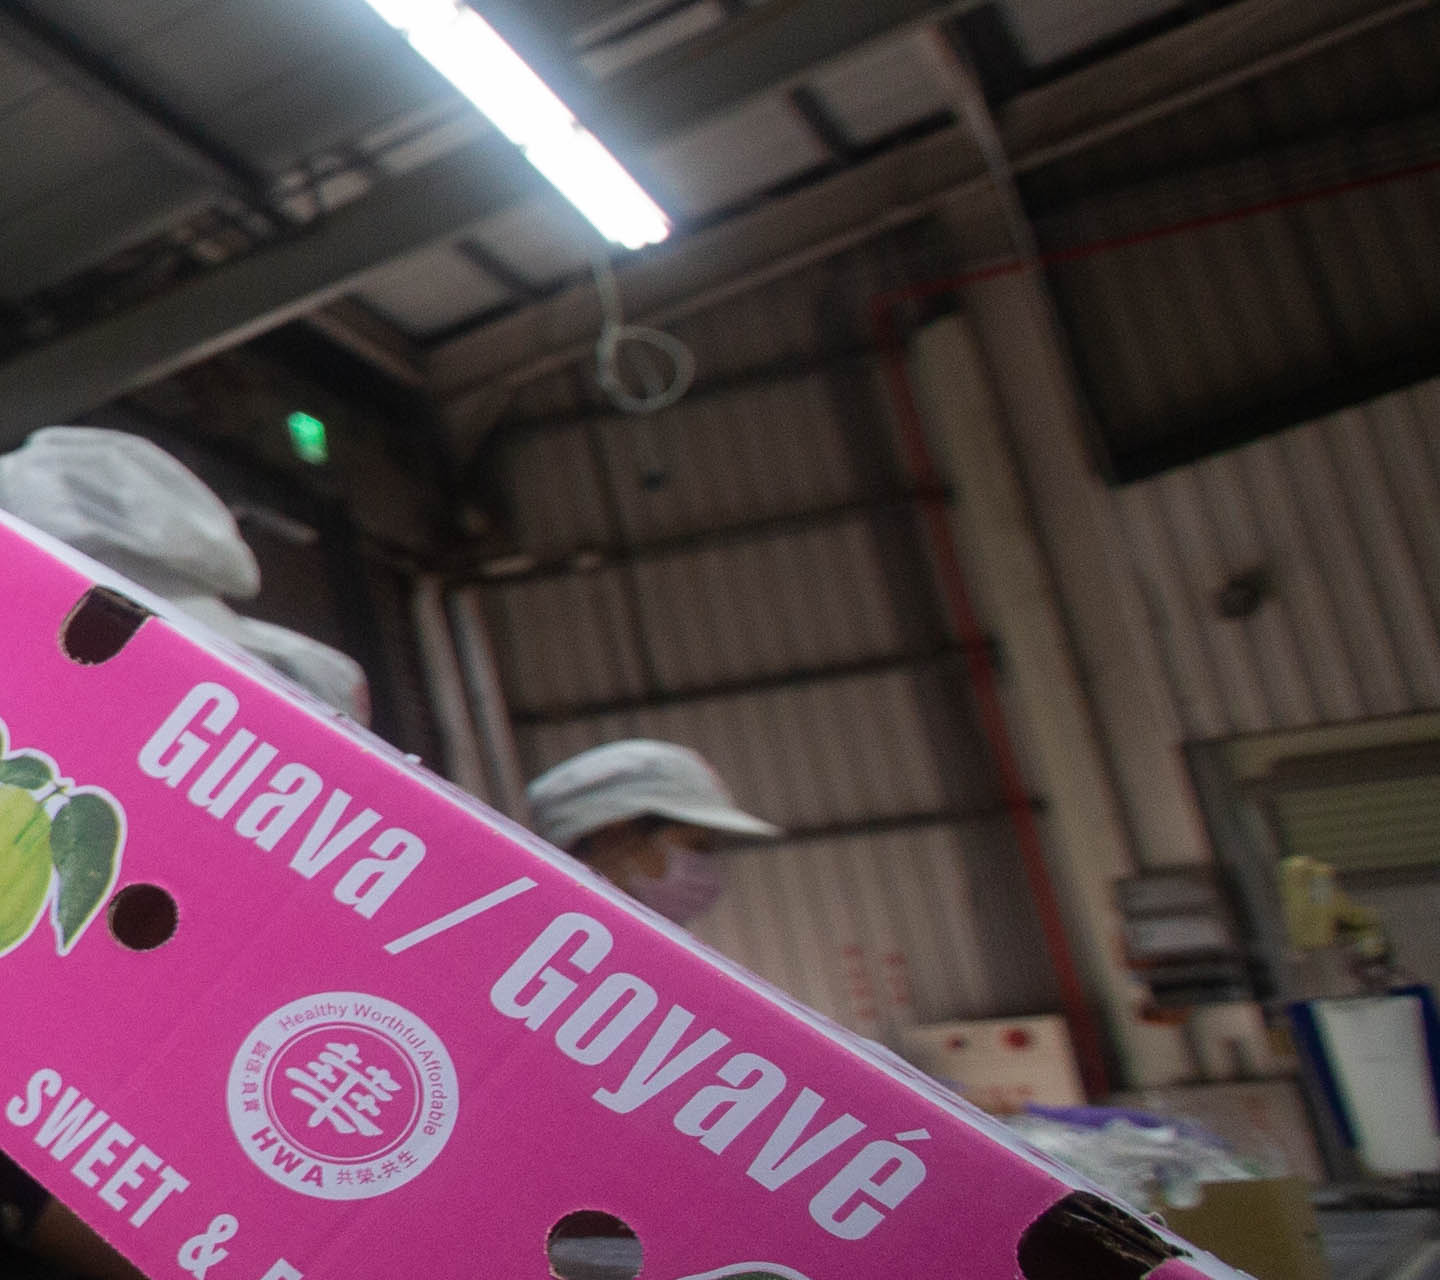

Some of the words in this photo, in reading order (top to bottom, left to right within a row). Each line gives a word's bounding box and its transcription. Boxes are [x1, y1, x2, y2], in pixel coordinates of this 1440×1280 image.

[135, 681, 428, 919] Guava
[489, 912, 931, 1241] Goyavé
[278, 1002, 348, 1032] Healthy
[353, 1003, 426, 1051] Worthful
[418, 1048, 449, 1137] Affordable
[5, 1068, 191, 1229] SWEET
[250, 1125, 326, 1188] HWA
